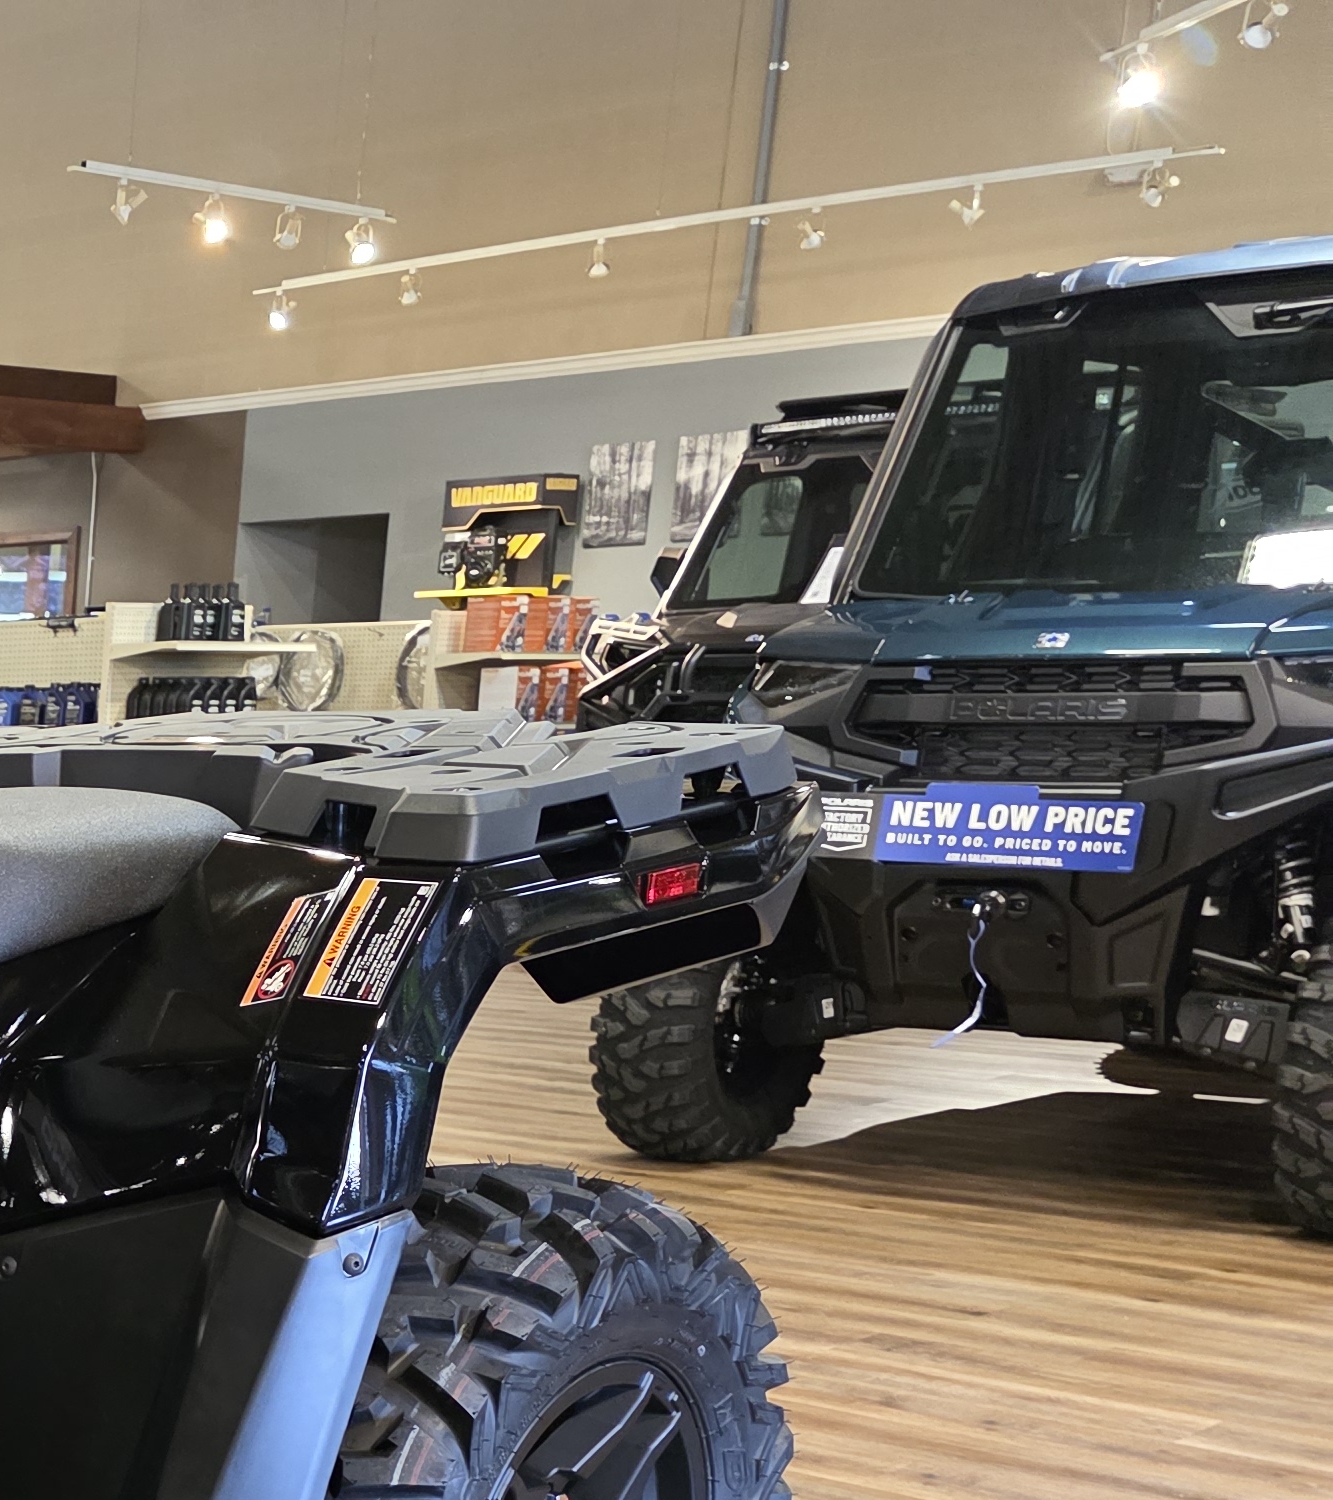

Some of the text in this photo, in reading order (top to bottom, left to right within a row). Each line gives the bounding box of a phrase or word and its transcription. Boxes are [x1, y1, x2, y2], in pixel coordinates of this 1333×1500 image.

[451, 481, 539, 508] VANGUARD
[949, 698, 1129, 721] POLARIS
[889, 800, 1135, 836] NEW LOW PRICE
[885, 832, 1127, 855] BUILT TO GO. PRICED TO MOVE.
[328, 904, 362, 956] WARNING
